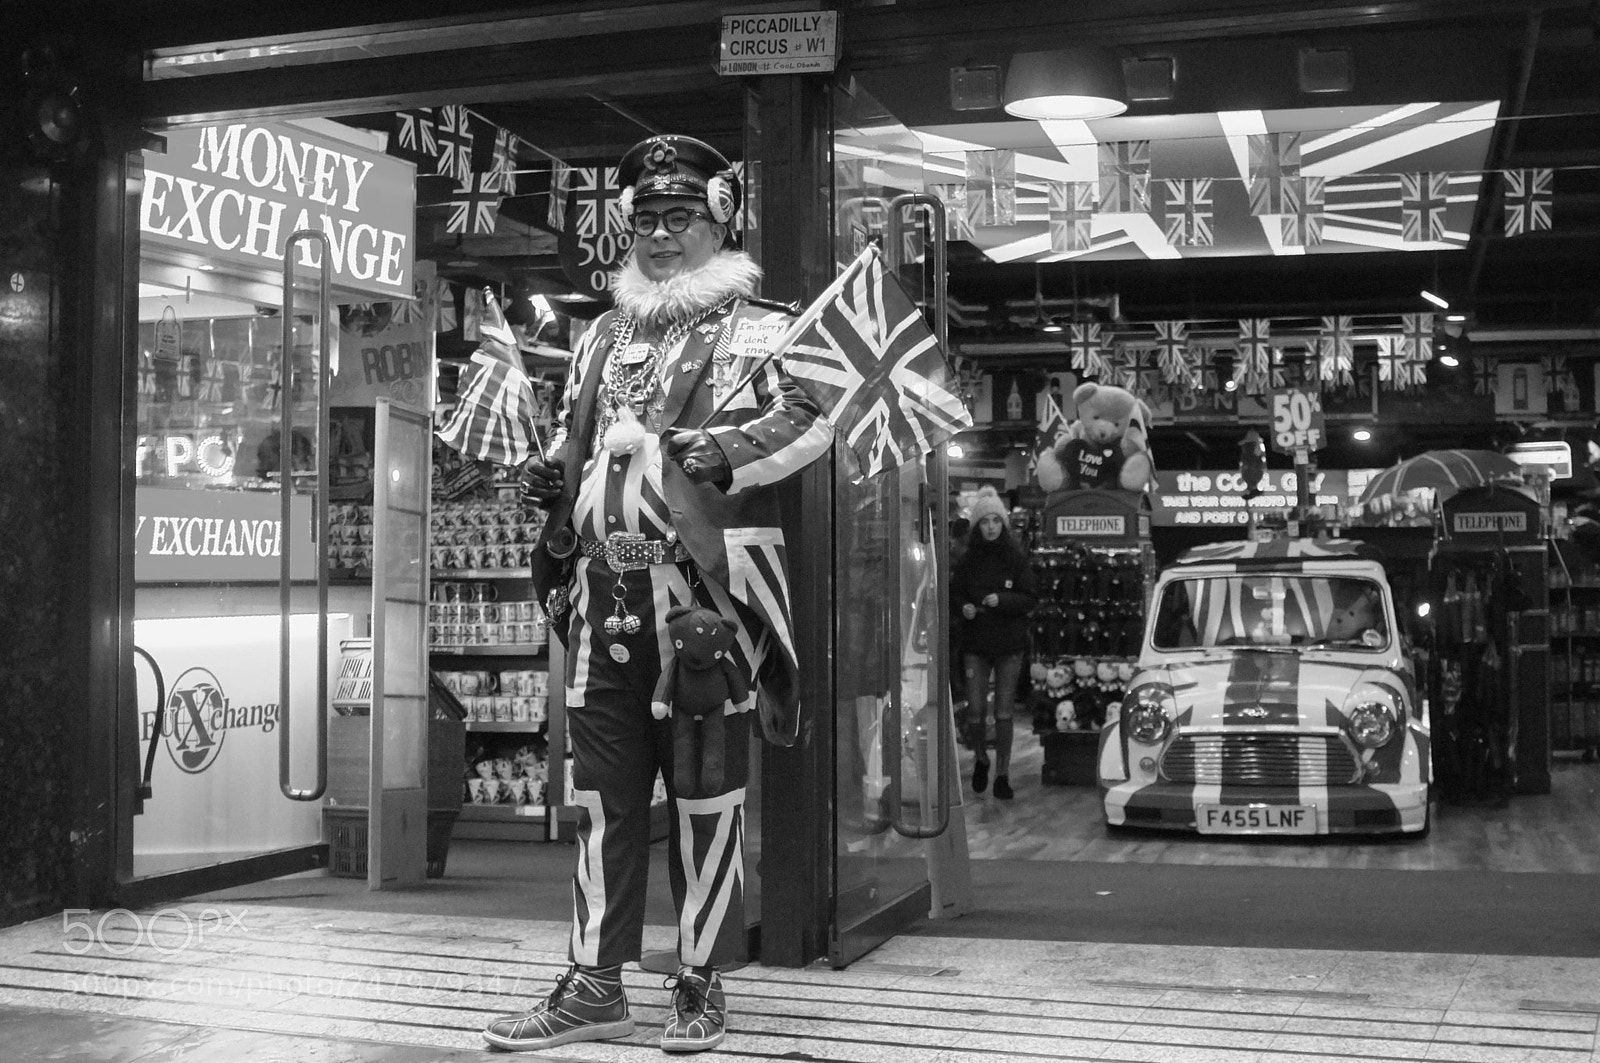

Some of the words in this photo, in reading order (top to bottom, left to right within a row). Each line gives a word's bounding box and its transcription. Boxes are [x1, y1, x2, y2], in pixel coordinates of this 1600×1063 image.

[731, 16, 821, 34] PICCADILLY
[730, 39, 788, 55] CIRCUS
[806, 38, 825, 52] W1
[192, 124, 374, 212] MONEY
[140, 169, 406, 286] EXCHANGE
[1274, 392, 1321, 433] 50%
[1276, 428, 1320, 448] OFF
[1079, 449, 1103, 466] Love
[1080, 463, 1099, 477] You
[1177, 472, 1211, 492] the
[1061, 519, 1122, 532] TELEPHONE
[1207, 809, 1260, 828] F455
[1264, 809, 1306, 828] LNF
